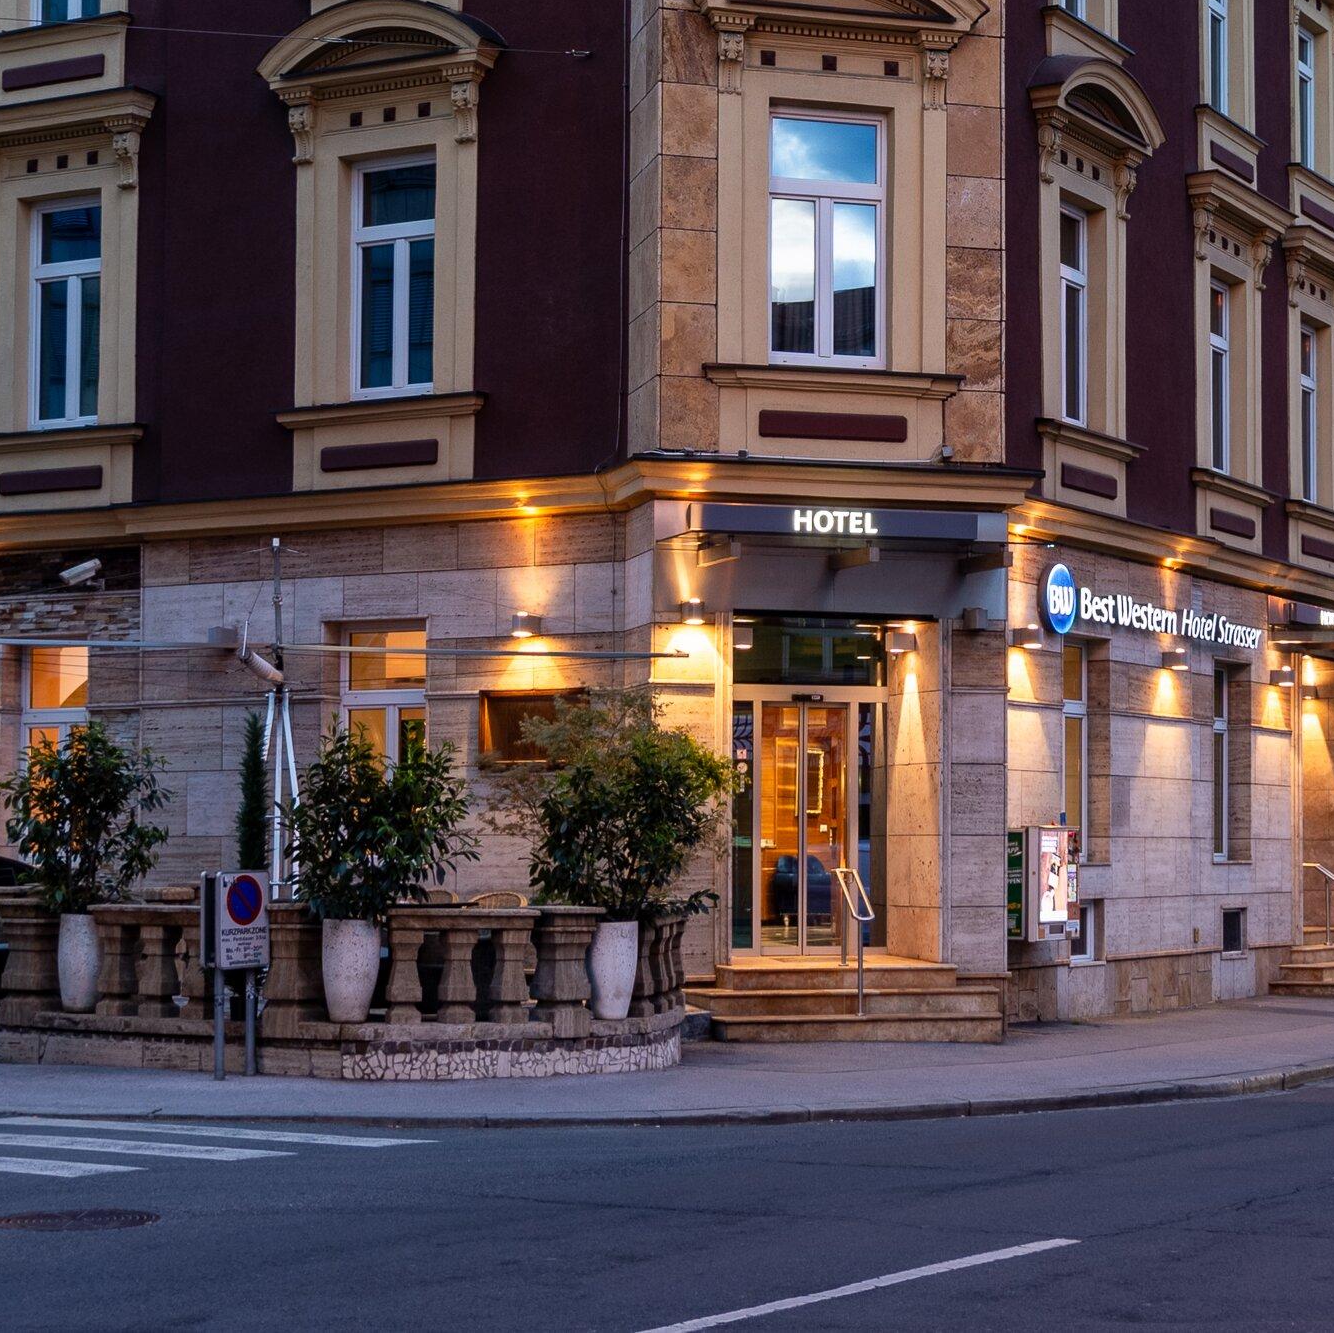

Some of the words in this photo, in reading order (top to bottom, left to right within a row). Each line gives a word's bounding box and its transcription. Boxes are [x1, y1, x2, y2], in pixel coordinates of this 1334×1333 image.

[793, 509, 879, 534] HOTEL
[1049, 584, 1073, 616] BW
[1080, 587, 1115, 625] Best
[1116, 594, 1178, 635] Western
[1181, 609, 1218, 642] Hotel
[1218, 616, 1262, 649] Strasser
